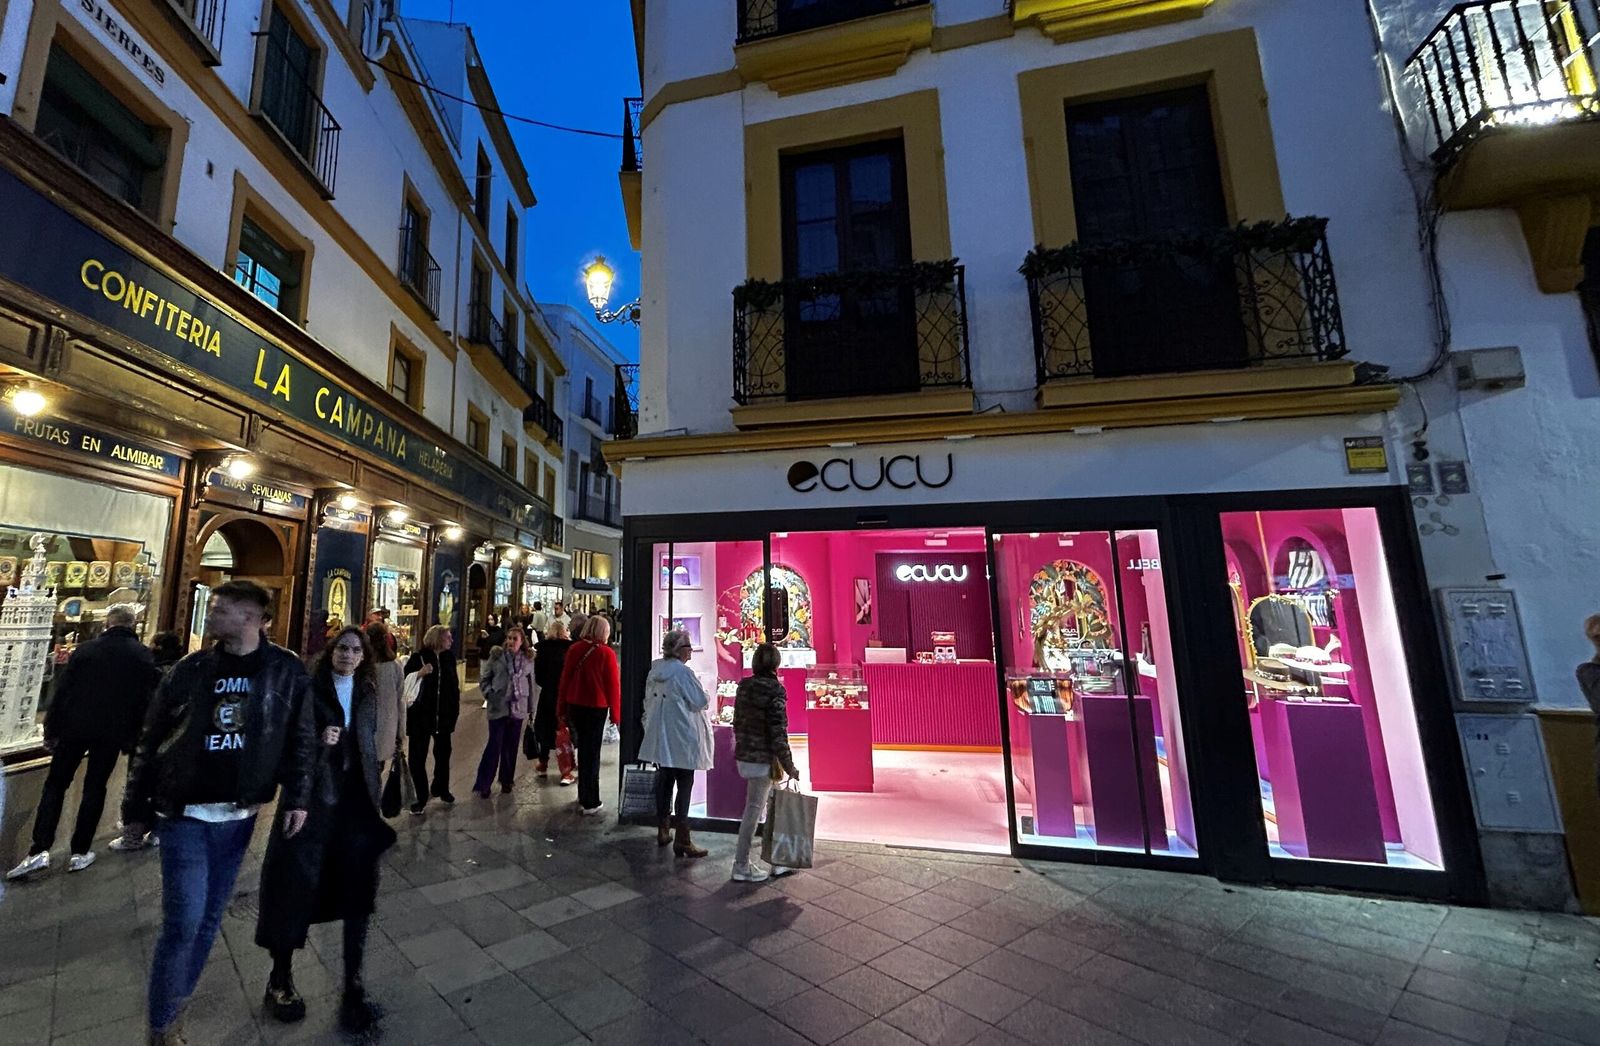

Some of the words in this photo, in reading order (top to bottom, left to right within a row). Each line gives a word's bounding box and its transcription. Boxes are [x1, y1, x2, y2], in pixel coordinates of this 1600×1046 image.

[81, 0, 165, 84] SIERPES
[80, 259, 221, 357] CONFITERIA
[253, 348, 290, 402] LA
[315, 386, 408, 459] CAMPANA
[13, 416, 71, 446] FRUTAS
[81, 435, 102, 453] EN
[110, 444, 164, 470] ALMIBAR
[251, 483, 293, 503] SEVILLANAS
